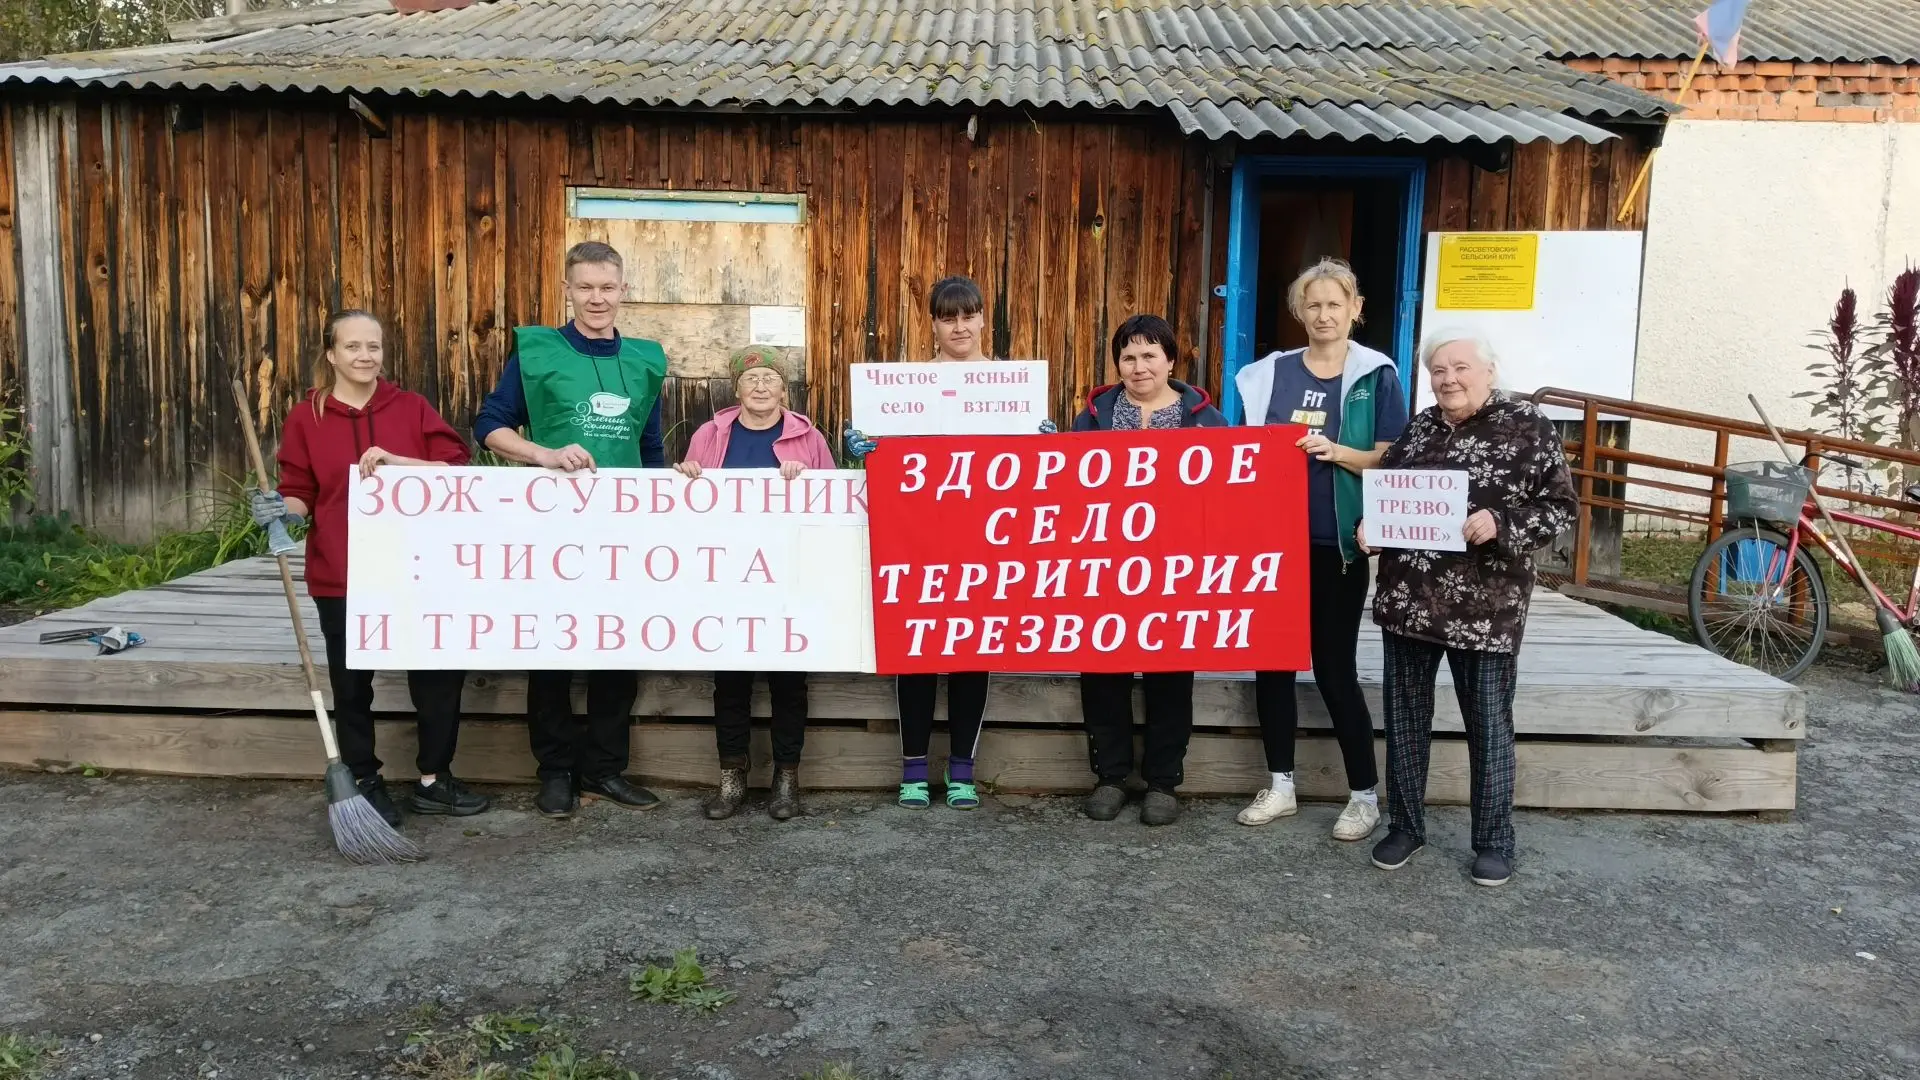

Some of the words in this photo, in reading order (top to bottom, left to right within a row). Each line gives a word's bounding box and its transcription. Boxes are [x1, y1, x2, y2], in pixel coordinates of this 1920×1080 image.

[866, 369, 938, 386] Чистое
[963, 367, 1030, 384] ясный
[880, 401, 925, 414] село
[963, 400, 1031, 415] взгляд
[1302, 389, 1327, 408] FIT
[900, 443, 1260, 500] ЗДОРОВОЕ
[1374, 474, 1459, 490] «ЧИСТО.
[357, 474, 484, 517] ЗОЖ
[1376, 499, 1455, 517] ТРЕЗВО.
[985, 501, 1156, 545] СЕЛО
[1381, 524, 1451, 542] НАШЕ»
[454, 544, 777, 584] ЧИСТОТА
[878, 552, 1284, 604] ТЕРРИТОРИЯ
[356, 614, 392, 652] И
[423, 614, 810, 653] ТРЕЗВОСТЬ
[905, 608, 1255, 656] ТРЕЗВОСТИ
